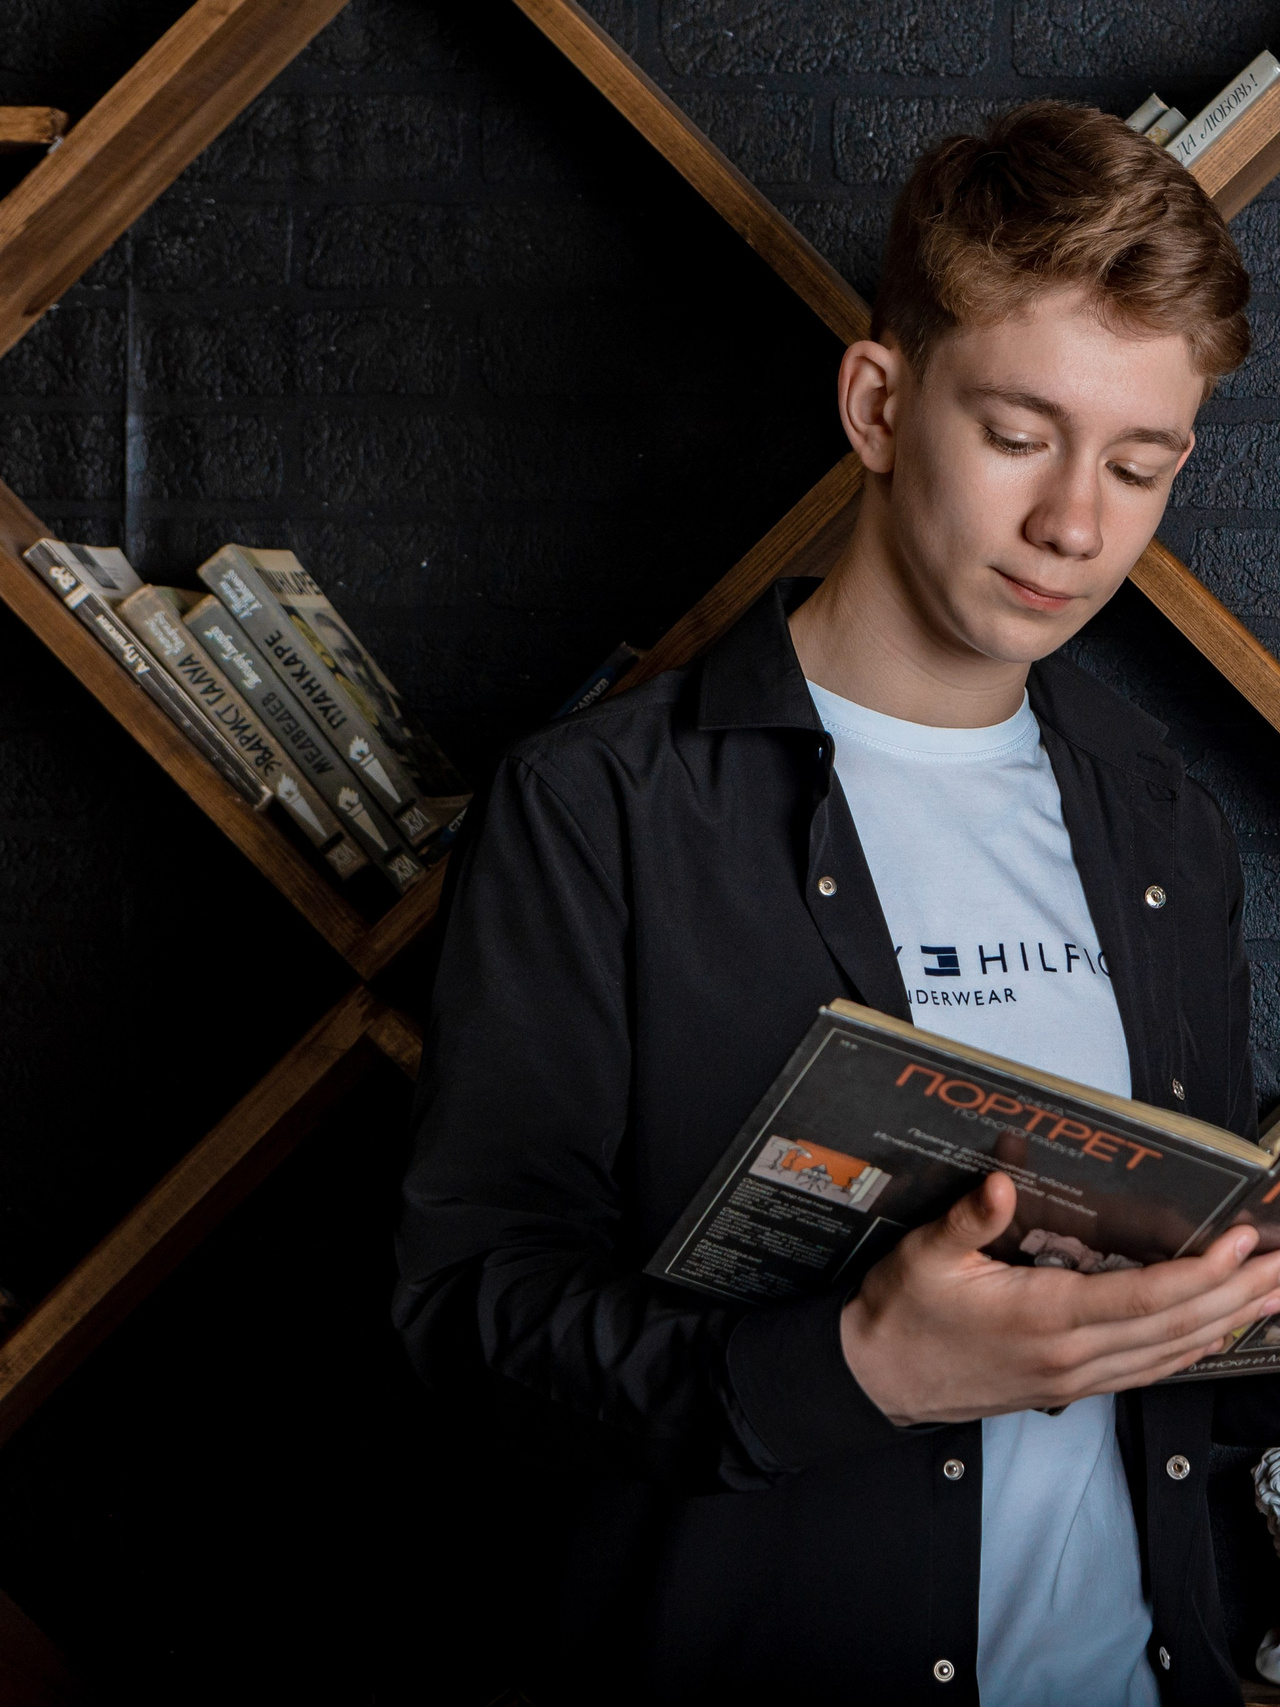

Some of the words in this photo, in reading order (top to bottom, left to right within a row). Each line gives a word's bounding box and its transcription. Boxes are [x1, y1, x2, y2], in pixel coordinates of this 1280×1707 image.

[177, 653, 224, 705] ГАЛУА
[265, 630, 347, 730] ПУАНКАРЕ
[216, 702, 281, 774] ЭВАРИСТ
[261, 692, 331, 775] МЕДВЕДЕВ
[892, 1061, 1166, 1176] ПОРТРЕТ
